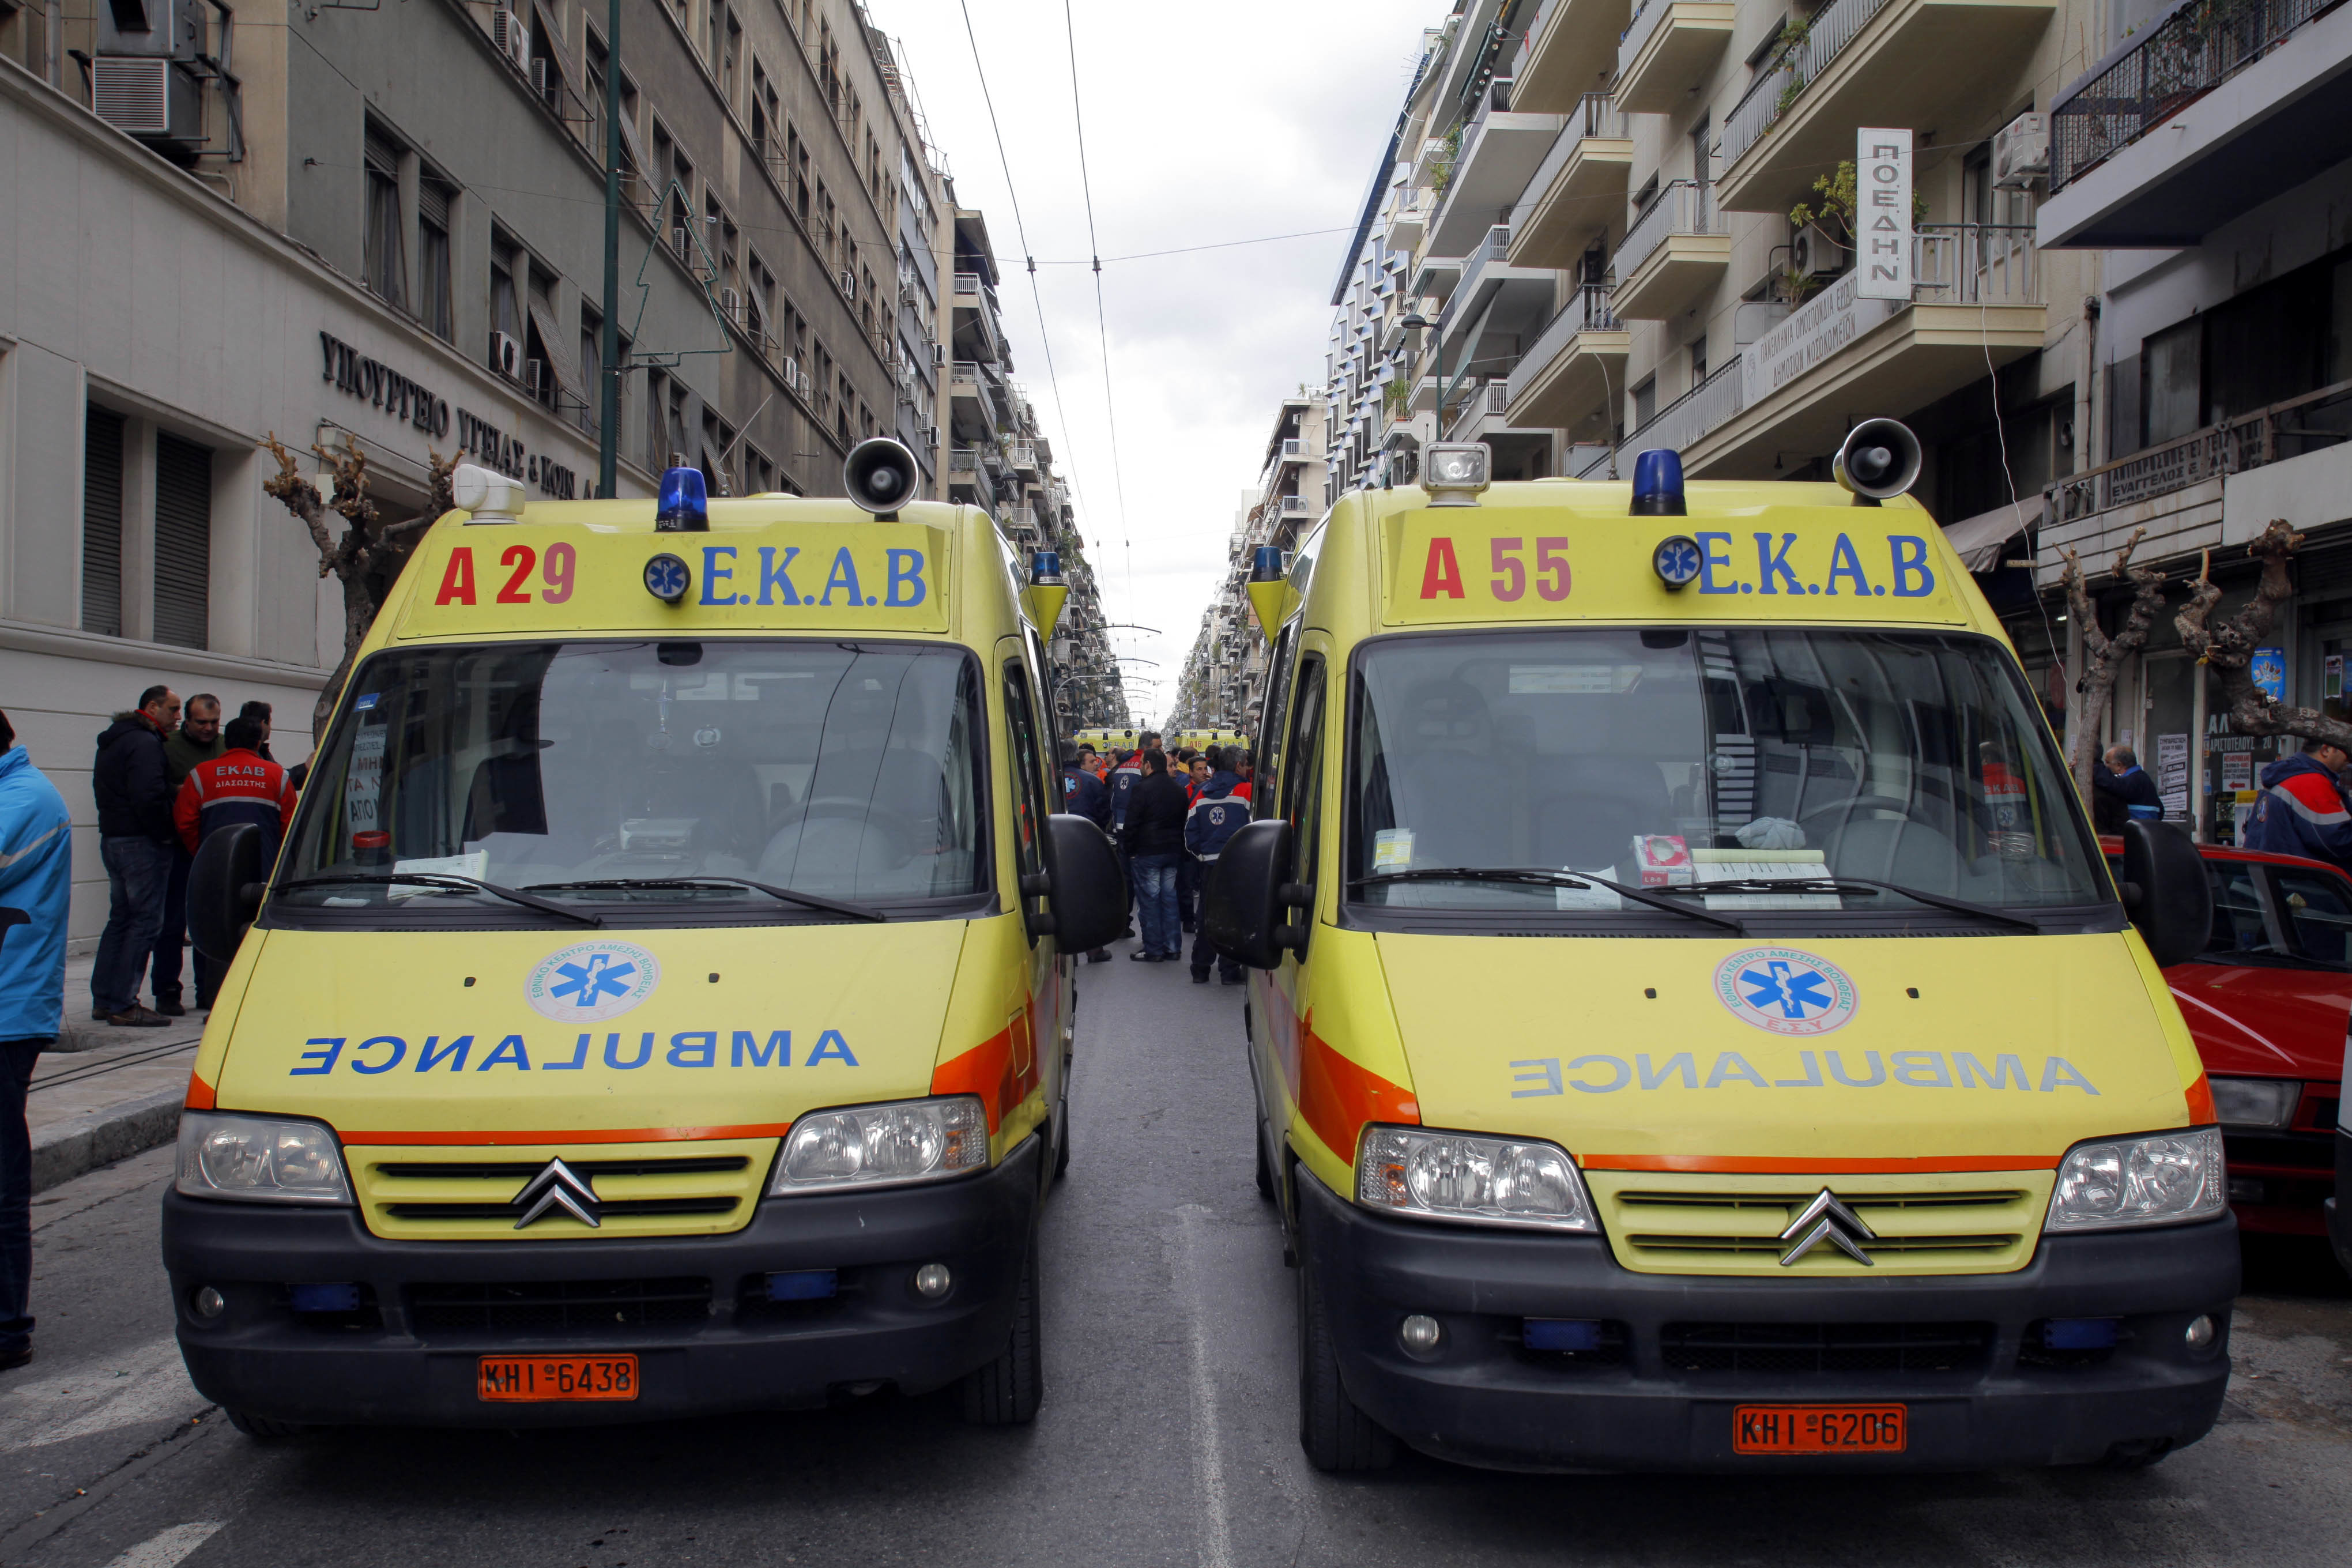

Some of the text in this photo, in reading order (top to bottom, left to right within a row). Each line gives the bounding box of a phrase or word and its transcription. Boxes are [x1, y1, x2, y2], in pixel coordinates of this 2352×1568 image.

[1761, 276, 1857, 365] ΠΑΝΕΛΛΗΝΙΑ ΟΜΟΣΠΟΝΔΙΑ ΕΡΓΑΖΟ
[1773, 313, 1856, 388] ΔΗΜΟΣΙΩΝ ΝΟΣΟΚΟΜΕΙΩΝ
[319, 331, 450, 438] ΥΠΟΥΡΓΕΙΟ
[457, 406, 525, 478] ΥΓΕΙΑΣ
[528, 454, 538, 483] &
[435, 541, 576, 606] A 29
[698, 545, 927, 607] Ε.Κ.Α.Β
[1419, 536, 1572, 602] A 55
[1694, 531, 1935, 598] Ε.Κ.Α.Β
[2208, 713, 2233, 734] ΑΛ
[2210, 736, 2272, 752] ΑΡΙΣΤΟΤΕΛΟΥΣ 20
[216, 765, 265, 777] ΕΚΑΒ
[216, 779, 267, 789] ΔΙΑΣΩΣΤΗΣ
[530, 943, 654, 1000] ΕΘΝΙΚΟ ΚΕΝΤΡΟ ΑΜΕΣΗΣ ΒΟΗΘΕΙΑΣ
[1720, 950, 1852, 1012] ΕΘΝΙΚΟ ΚΕΝΤΡΟ ΑΜΕΣΗΣ ΒΟΗΘΕΙΑΣ
